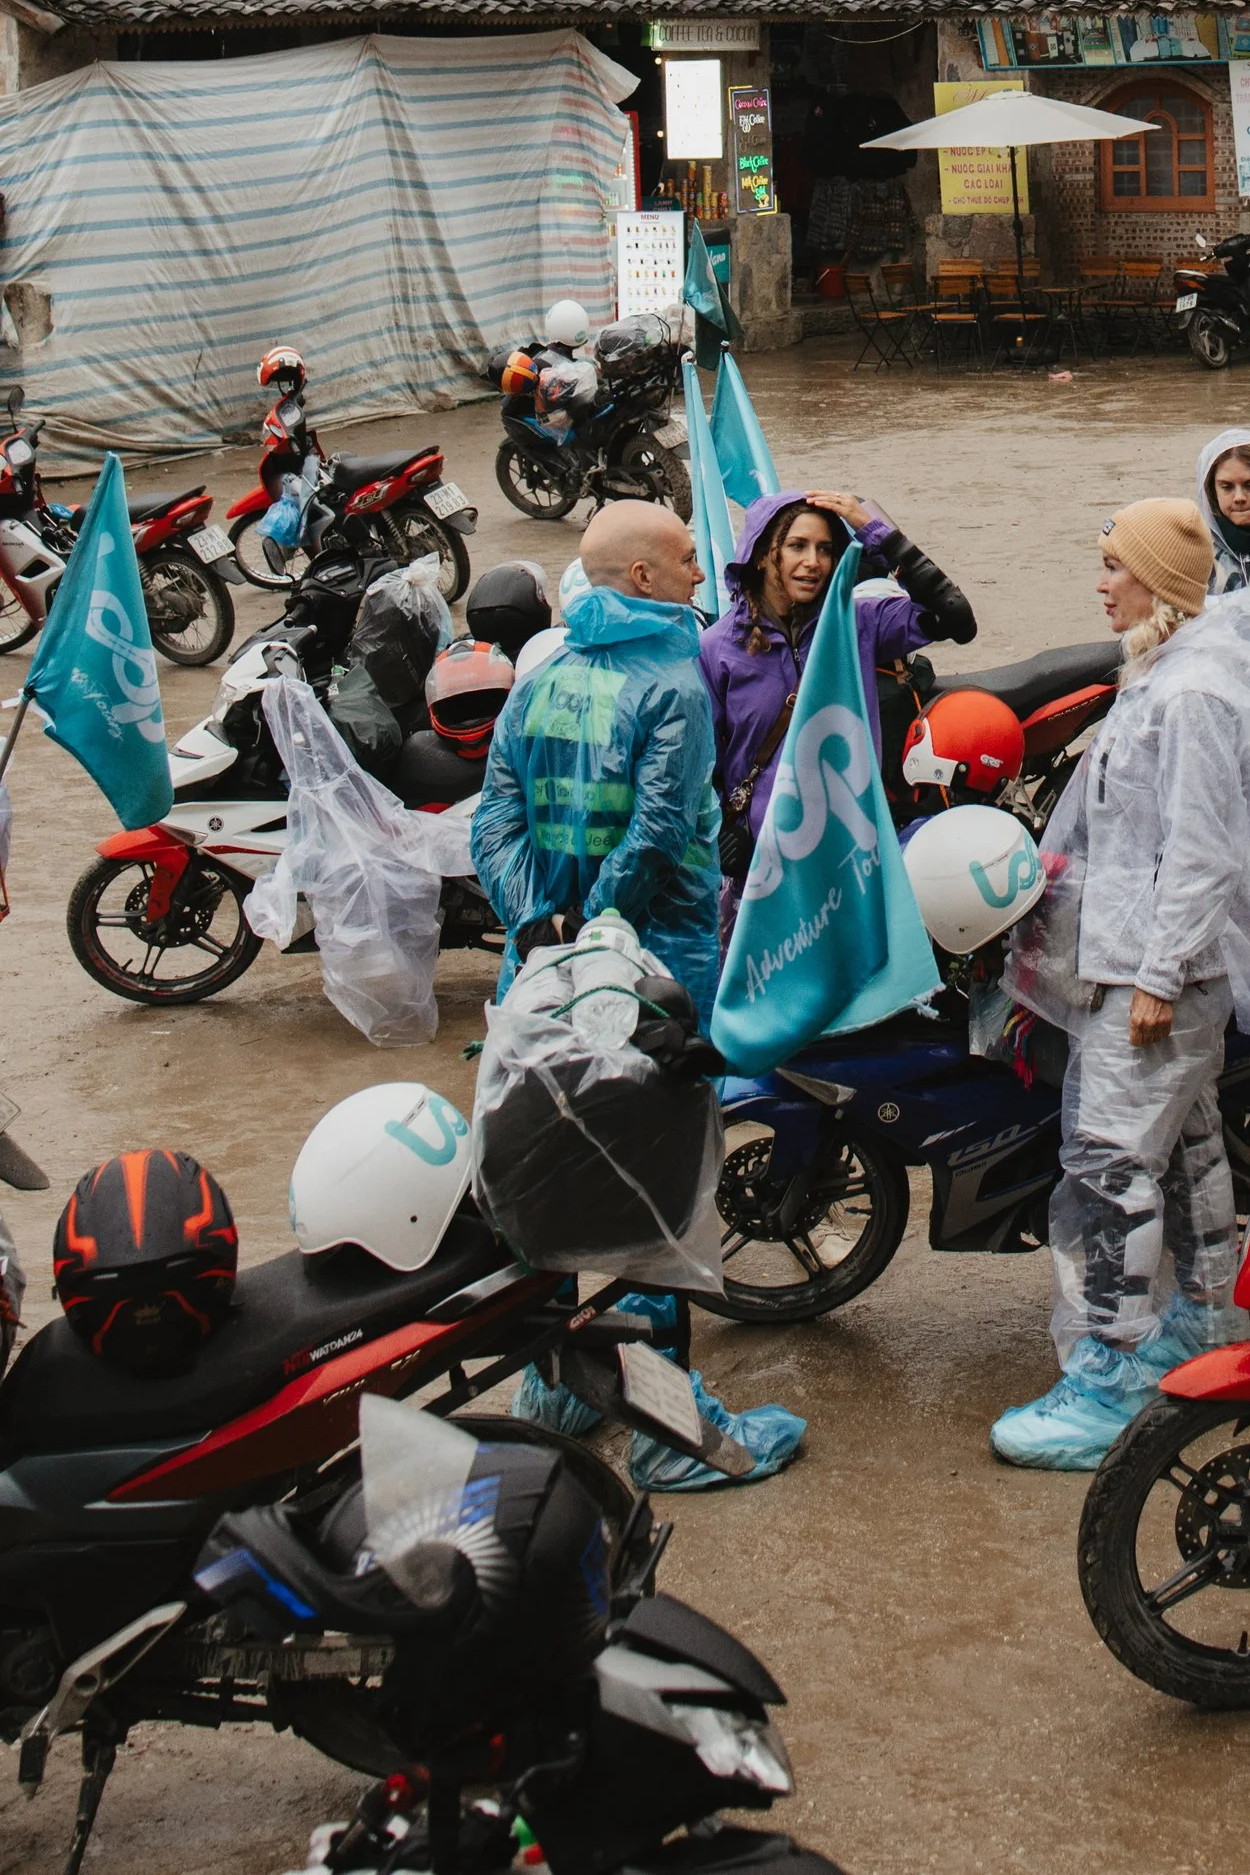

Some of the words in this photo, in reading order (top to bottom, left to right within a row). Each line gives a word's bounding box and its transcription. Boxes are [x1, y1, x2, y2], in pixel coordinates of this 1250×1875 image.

[715, 25, 723, 42] &
[749, 113, 766, 125] Coffee
[738, 156, 756, 174] Black
[752, 154, 769, 167] Coffee
[752, 175, 769, 187] Coffee
[585, 832, 613, 847] Jee
[744, 886, 843, 1003] Adventure
